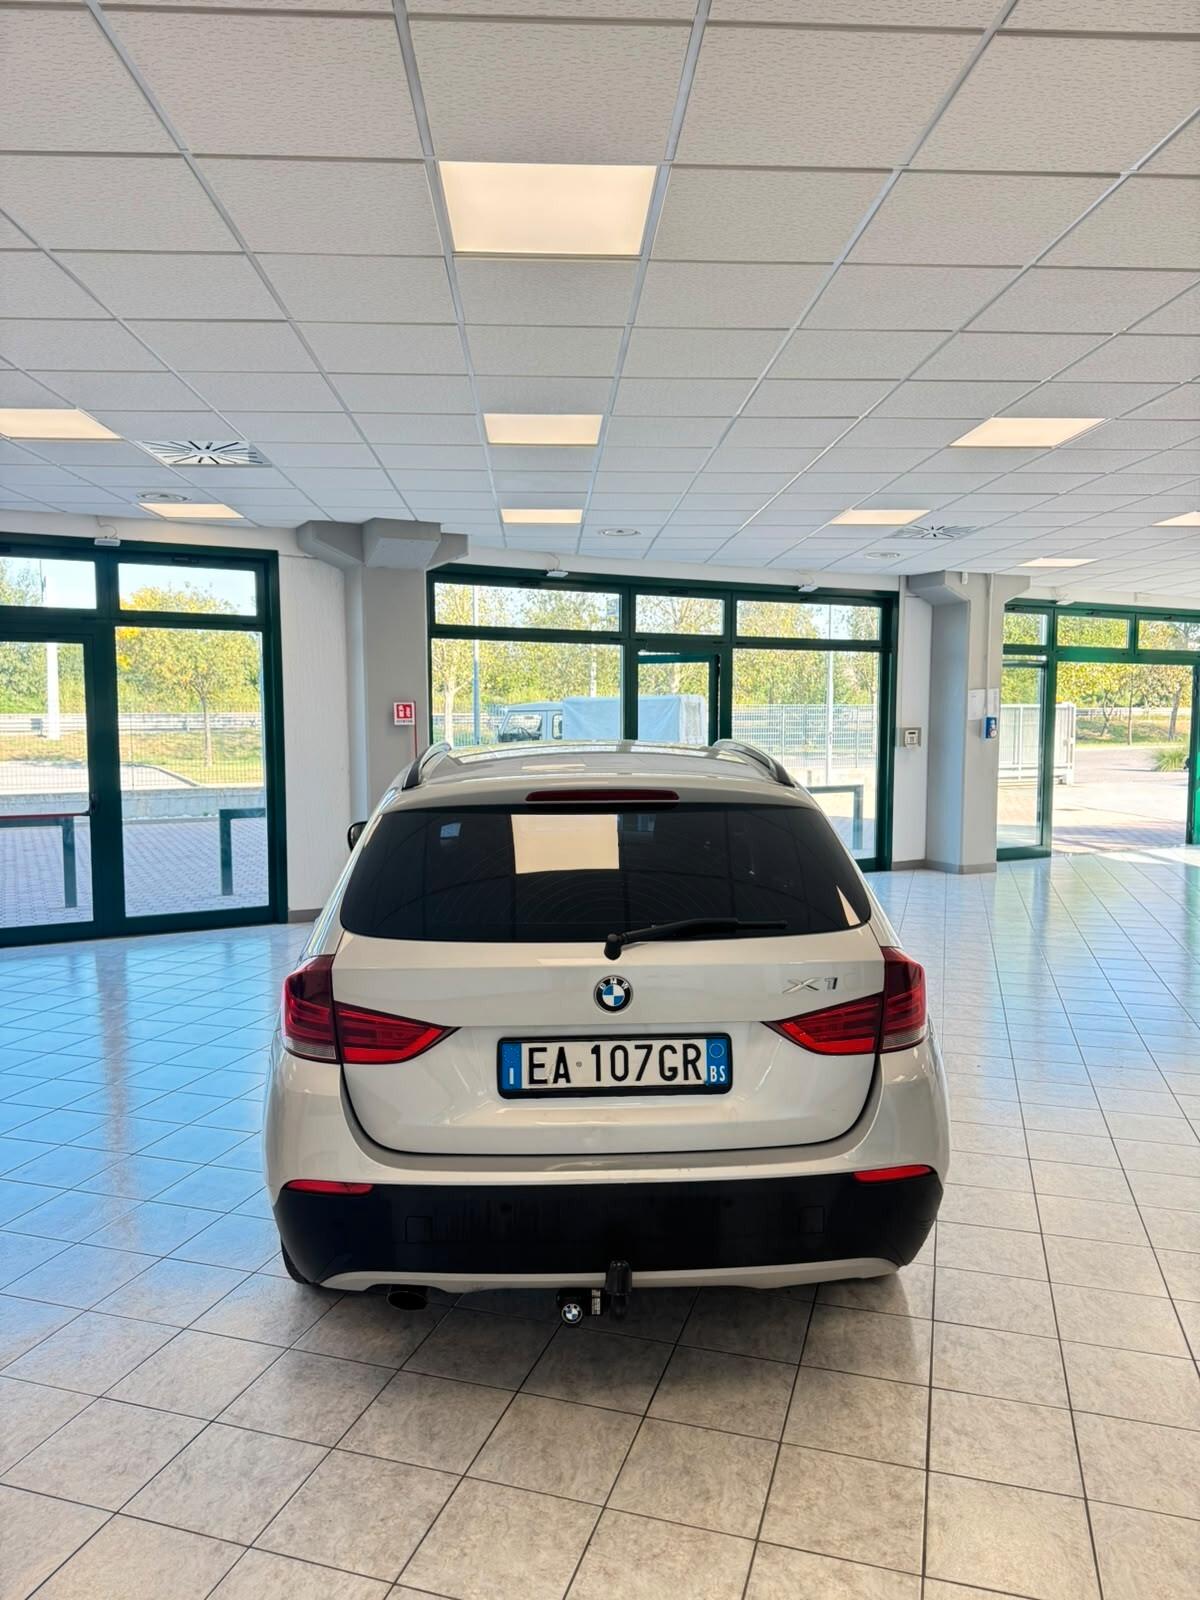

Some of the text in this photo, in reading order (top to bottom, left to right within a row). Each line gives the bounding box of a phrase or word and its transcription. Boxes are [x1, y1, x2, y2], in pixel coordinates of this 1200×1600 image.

[782, 977, 838, 994] X1
[528, 1043, 702, 1085] EA 107GR
[709, 1065, 726, 1082] BS
